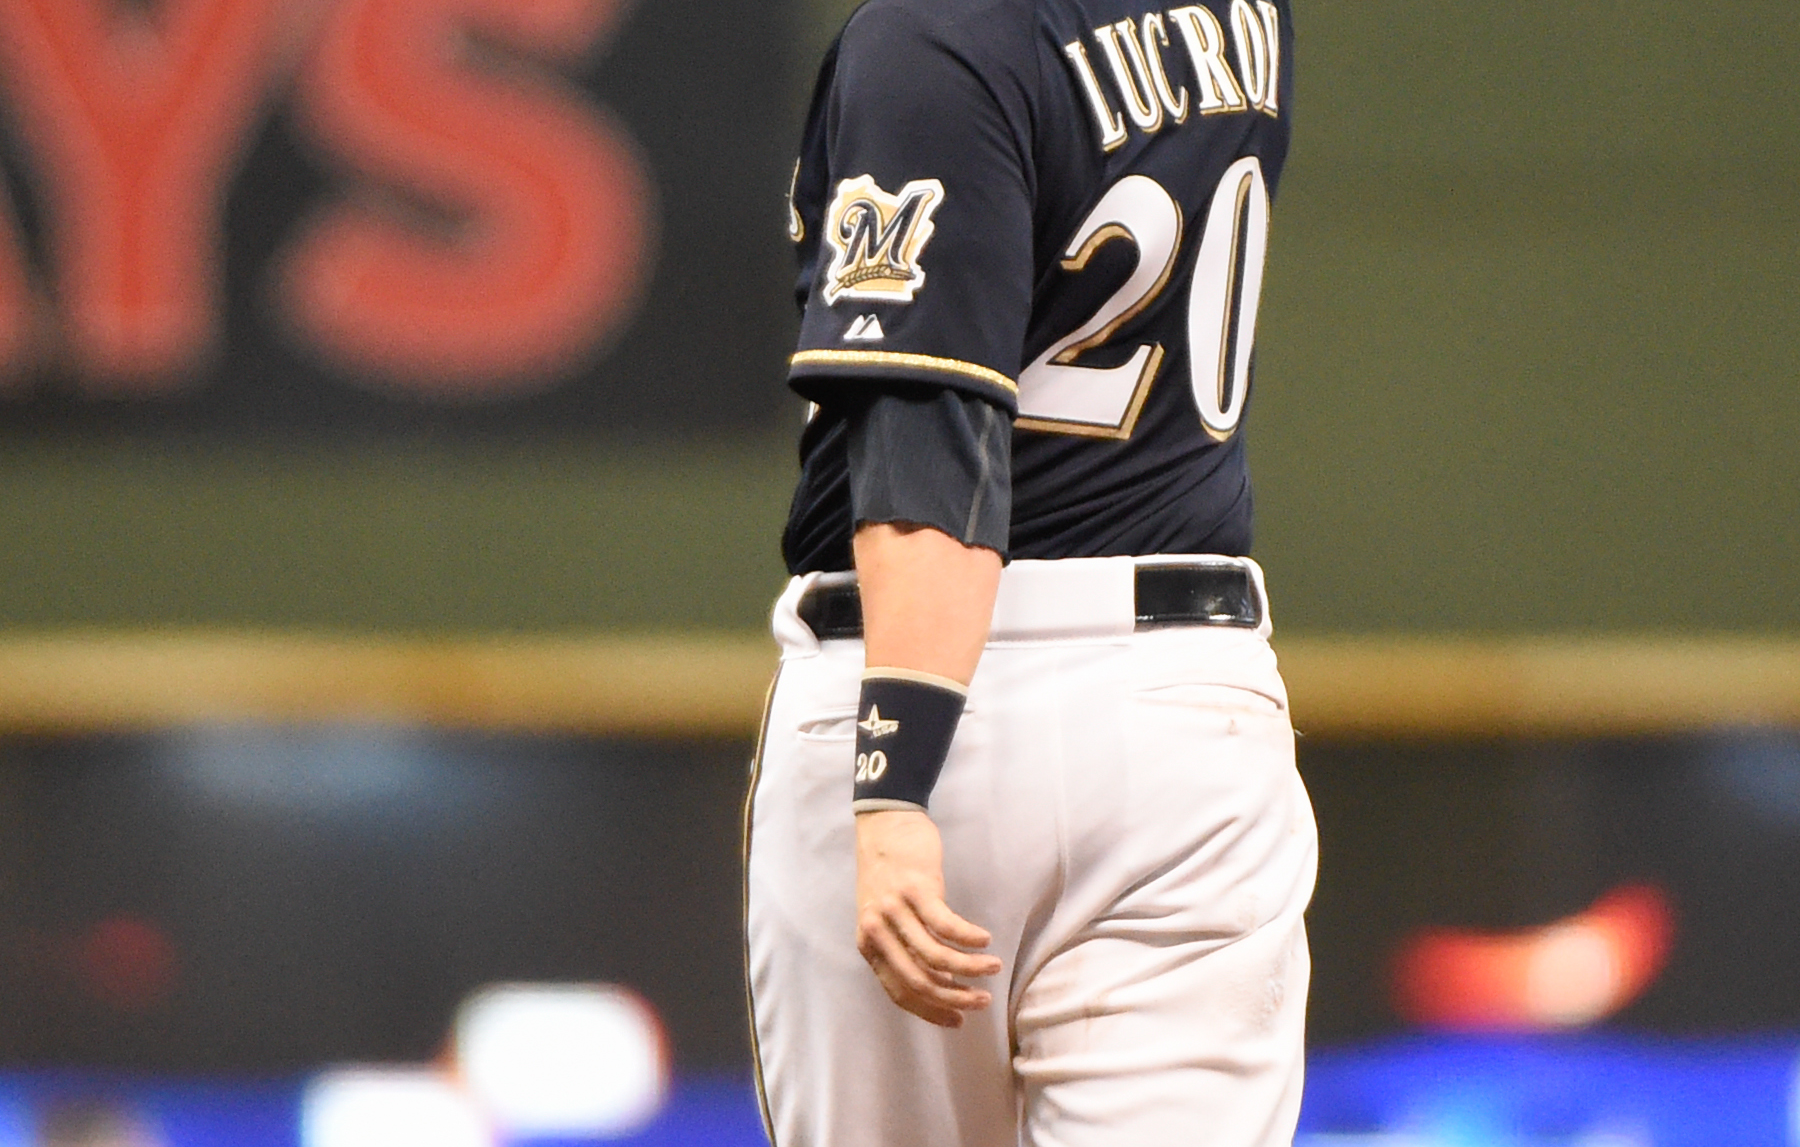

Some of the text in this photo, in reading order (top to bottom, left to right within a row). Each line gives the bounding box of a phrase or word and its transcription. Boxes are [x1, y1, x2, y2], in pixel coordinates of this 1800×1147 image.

[836, 188, 935, 280] M
[1012, 155, 1270, 443] 20
[855, 750, 888, 783] 20
